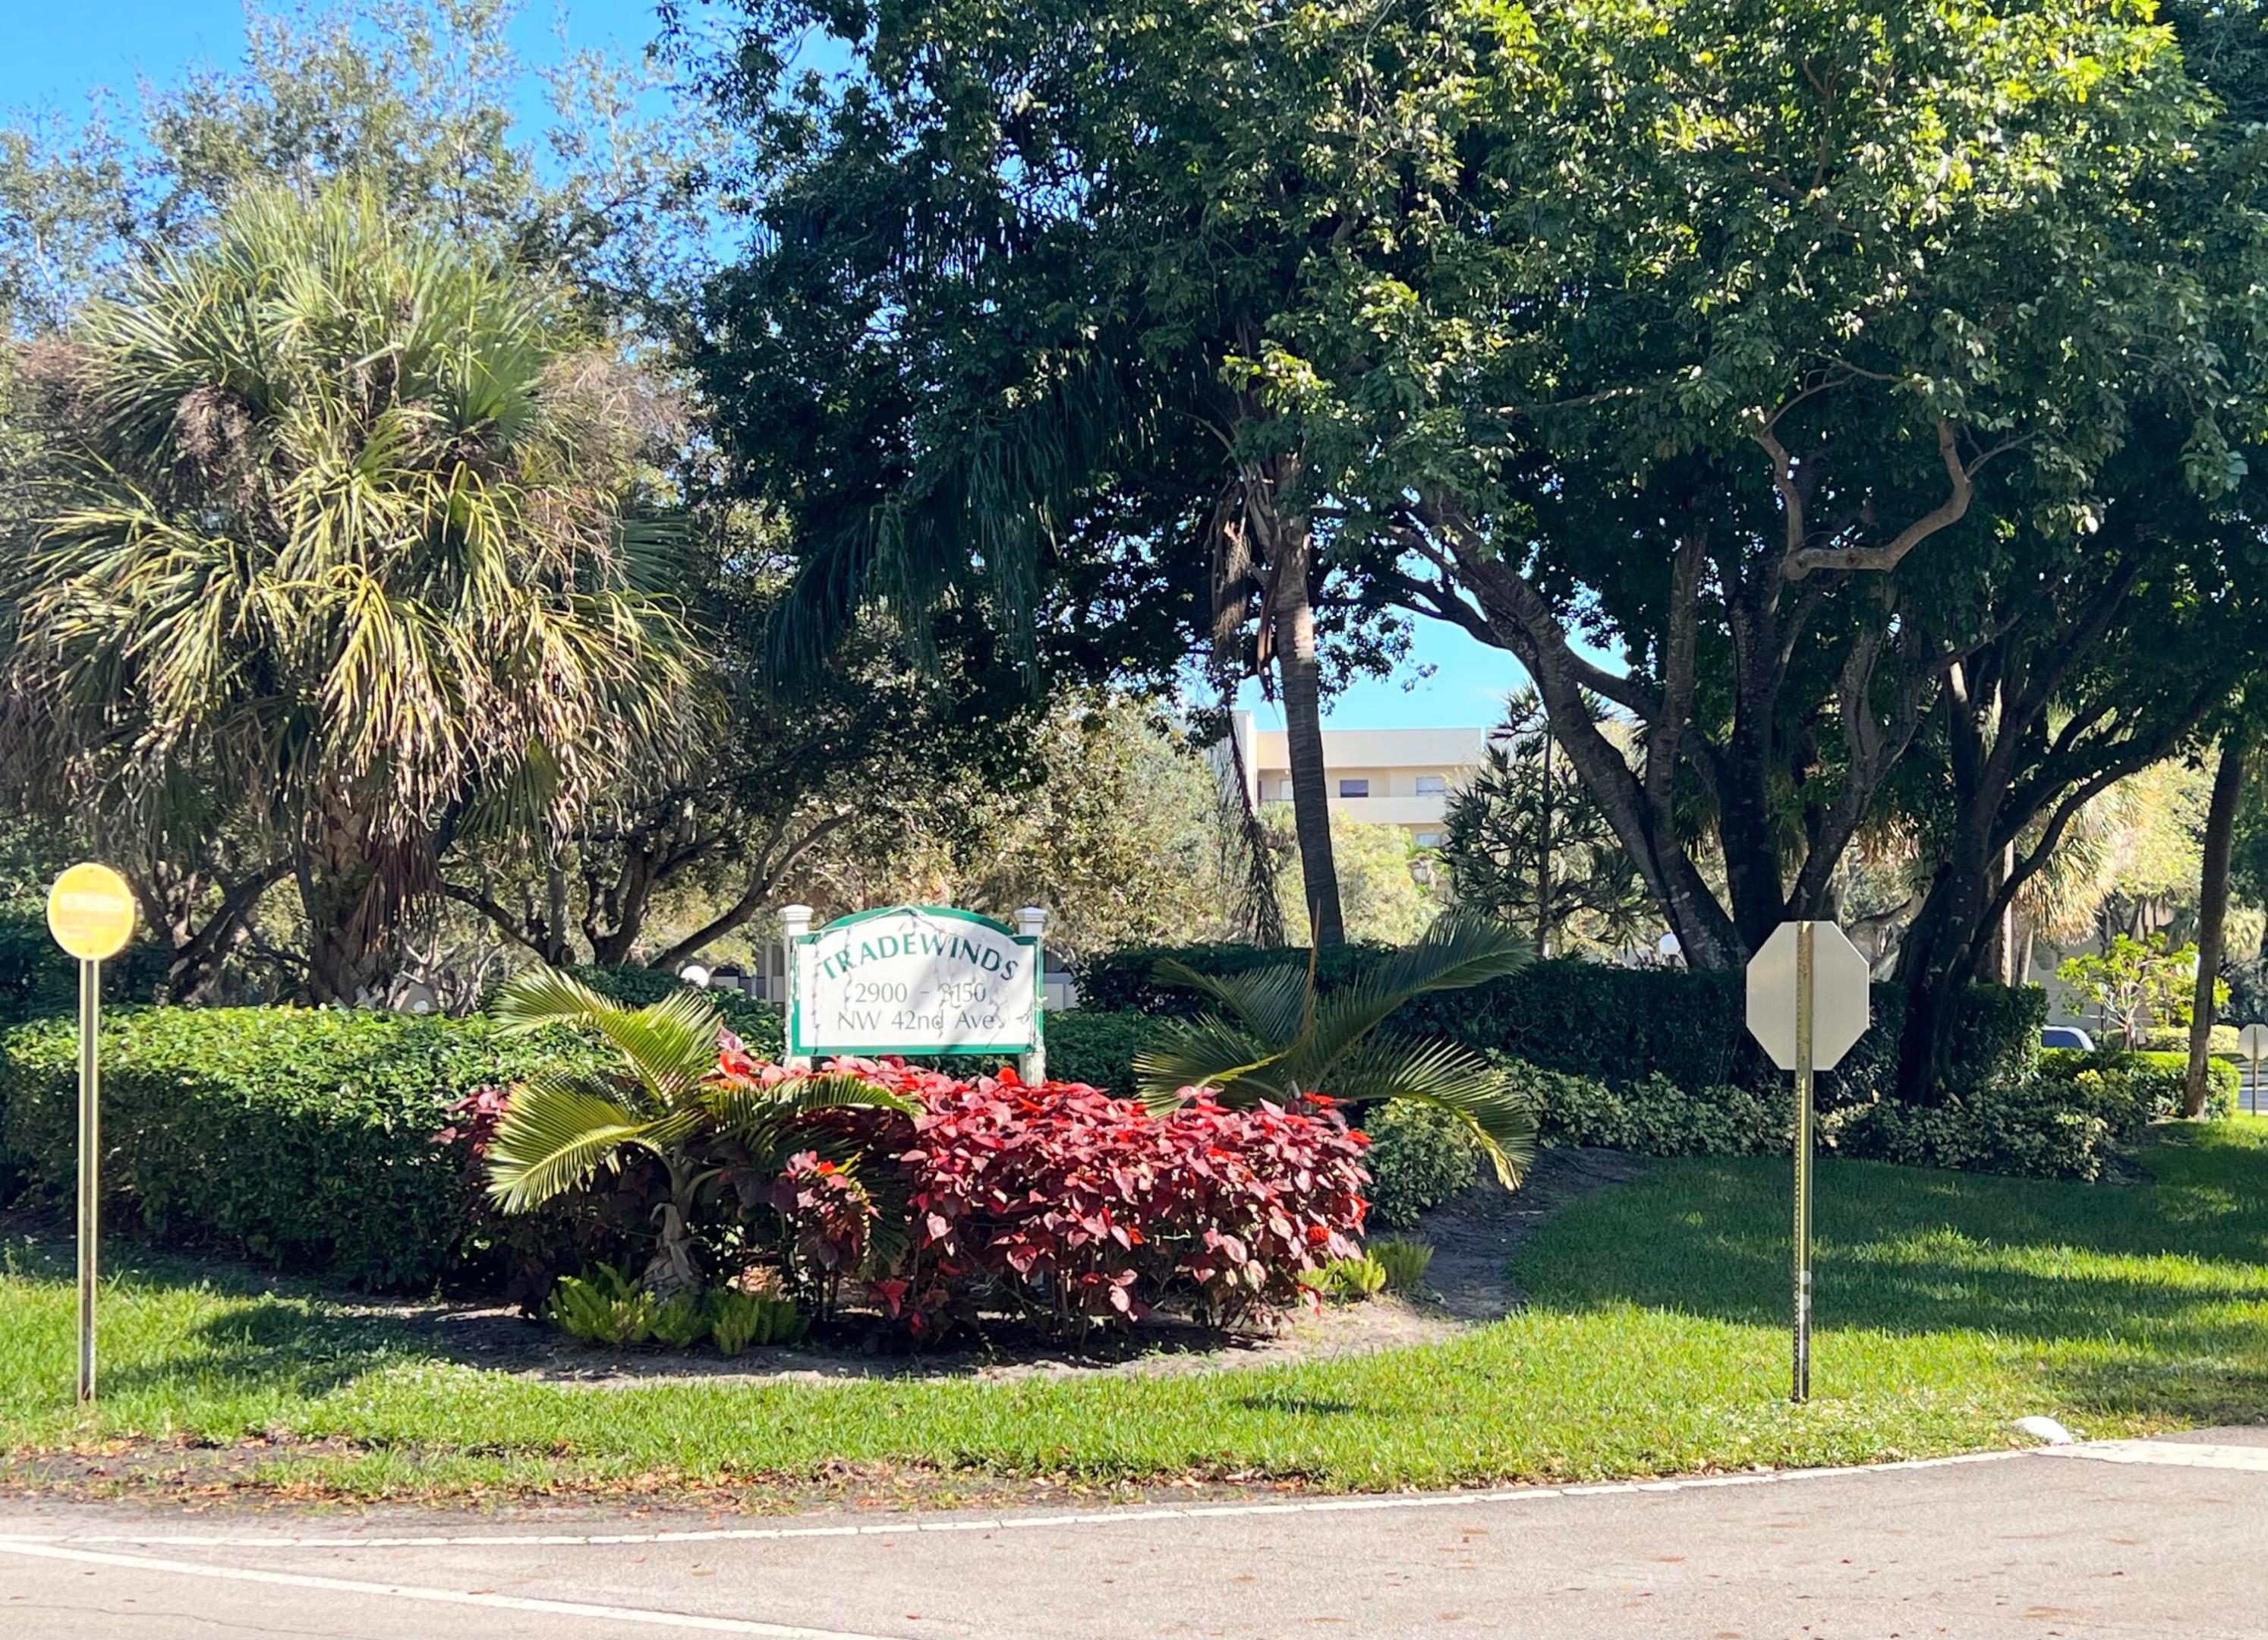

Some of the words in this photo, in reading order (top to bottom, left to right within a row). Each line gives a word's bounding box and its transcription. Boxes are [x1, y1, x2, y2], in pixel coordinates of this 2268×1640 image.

[817, 932, 1019, 981] TRADEWINDS
[854, 982, 909, 1004] 2900
[837, 1010, 882, 1031] NW
[890, 1009, 944, 1031] 42nd
